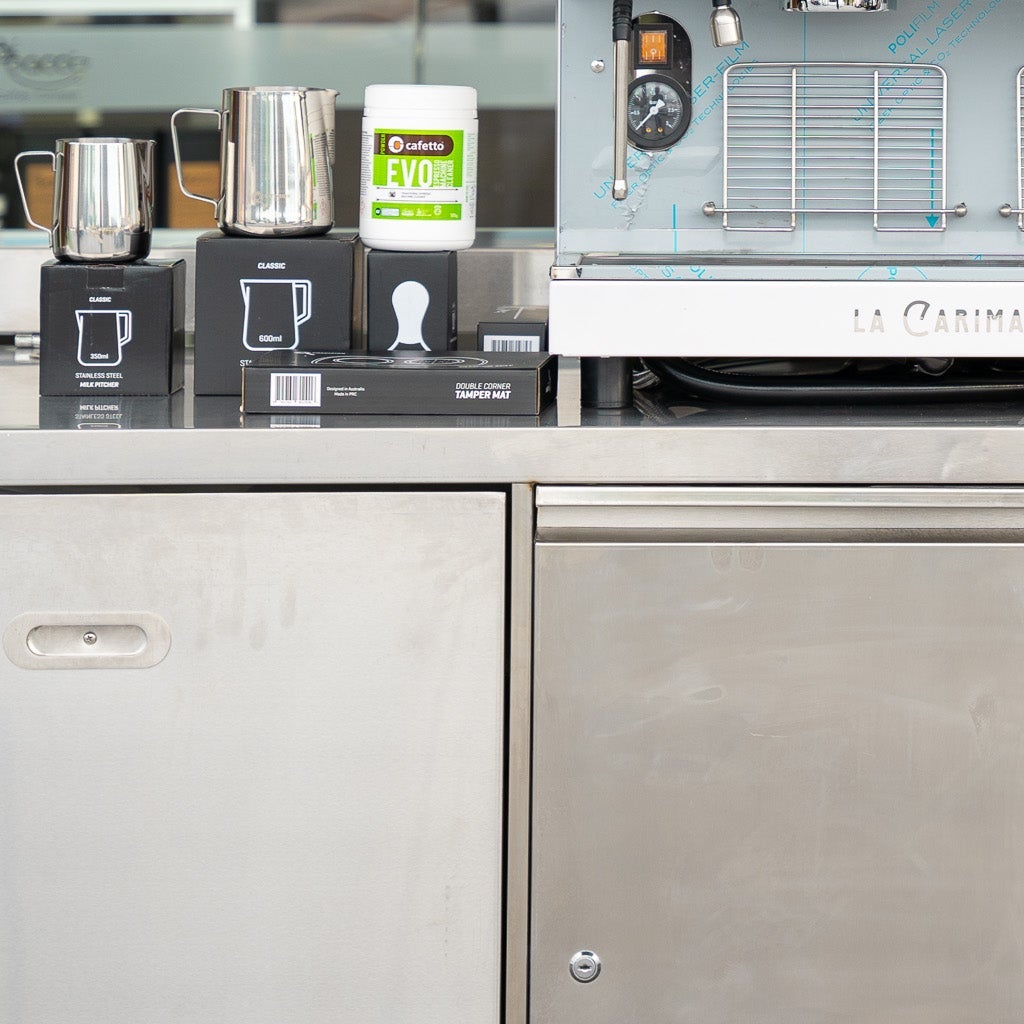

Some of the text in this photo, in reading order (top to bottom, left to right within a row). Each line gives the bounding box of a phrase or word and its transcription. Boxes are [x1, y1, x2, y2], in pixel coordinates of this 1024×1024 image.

[888, 0, 941, 54] POLIFILM
[405, 140, 445, 151] cafetto
[387, 158, 433, 187] EVO
[257, 262, 286, 270] CLASSIC
[854, 309, 884, 333] LA
[258, 334, 282, 343] 600ml
[455, 390, 512, 399] TAMPER MAT
